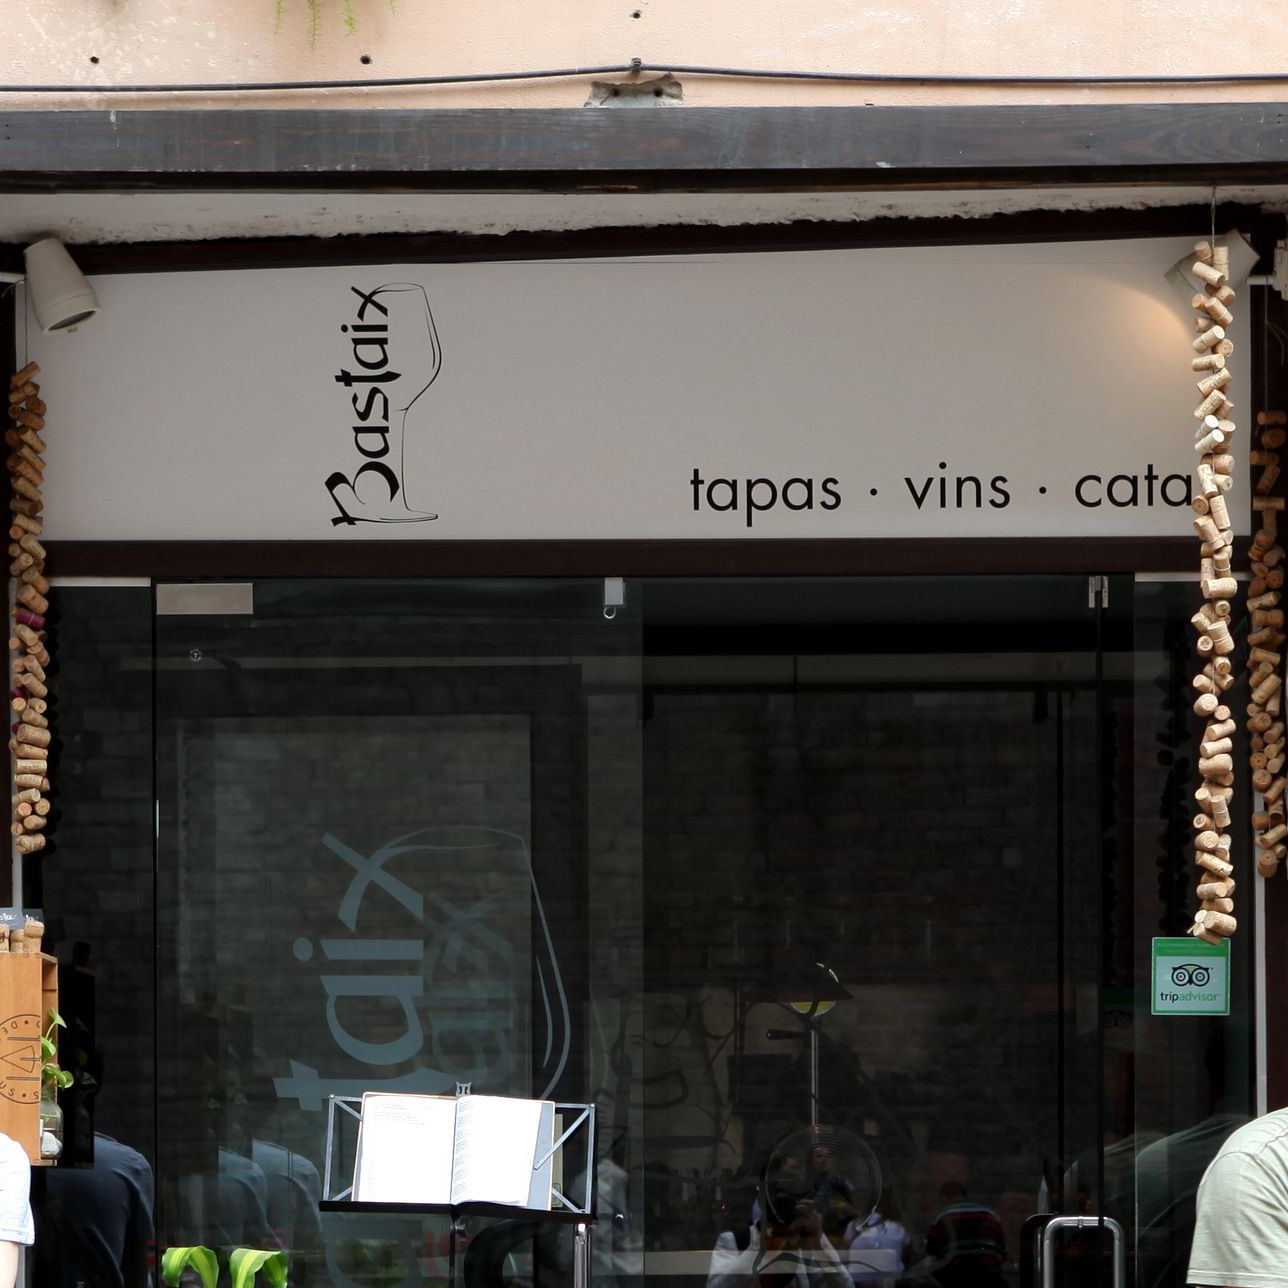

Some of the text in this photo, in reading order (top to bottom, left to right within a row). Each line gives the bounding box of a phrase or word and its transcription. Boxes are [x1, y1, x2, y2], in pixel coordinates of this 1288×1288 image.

[325, 286, 400, 526] Bastaix
[690, 461, 1193, 528] tapas vins cata
[1160, 991, 1218, 1003] tripadvisor
